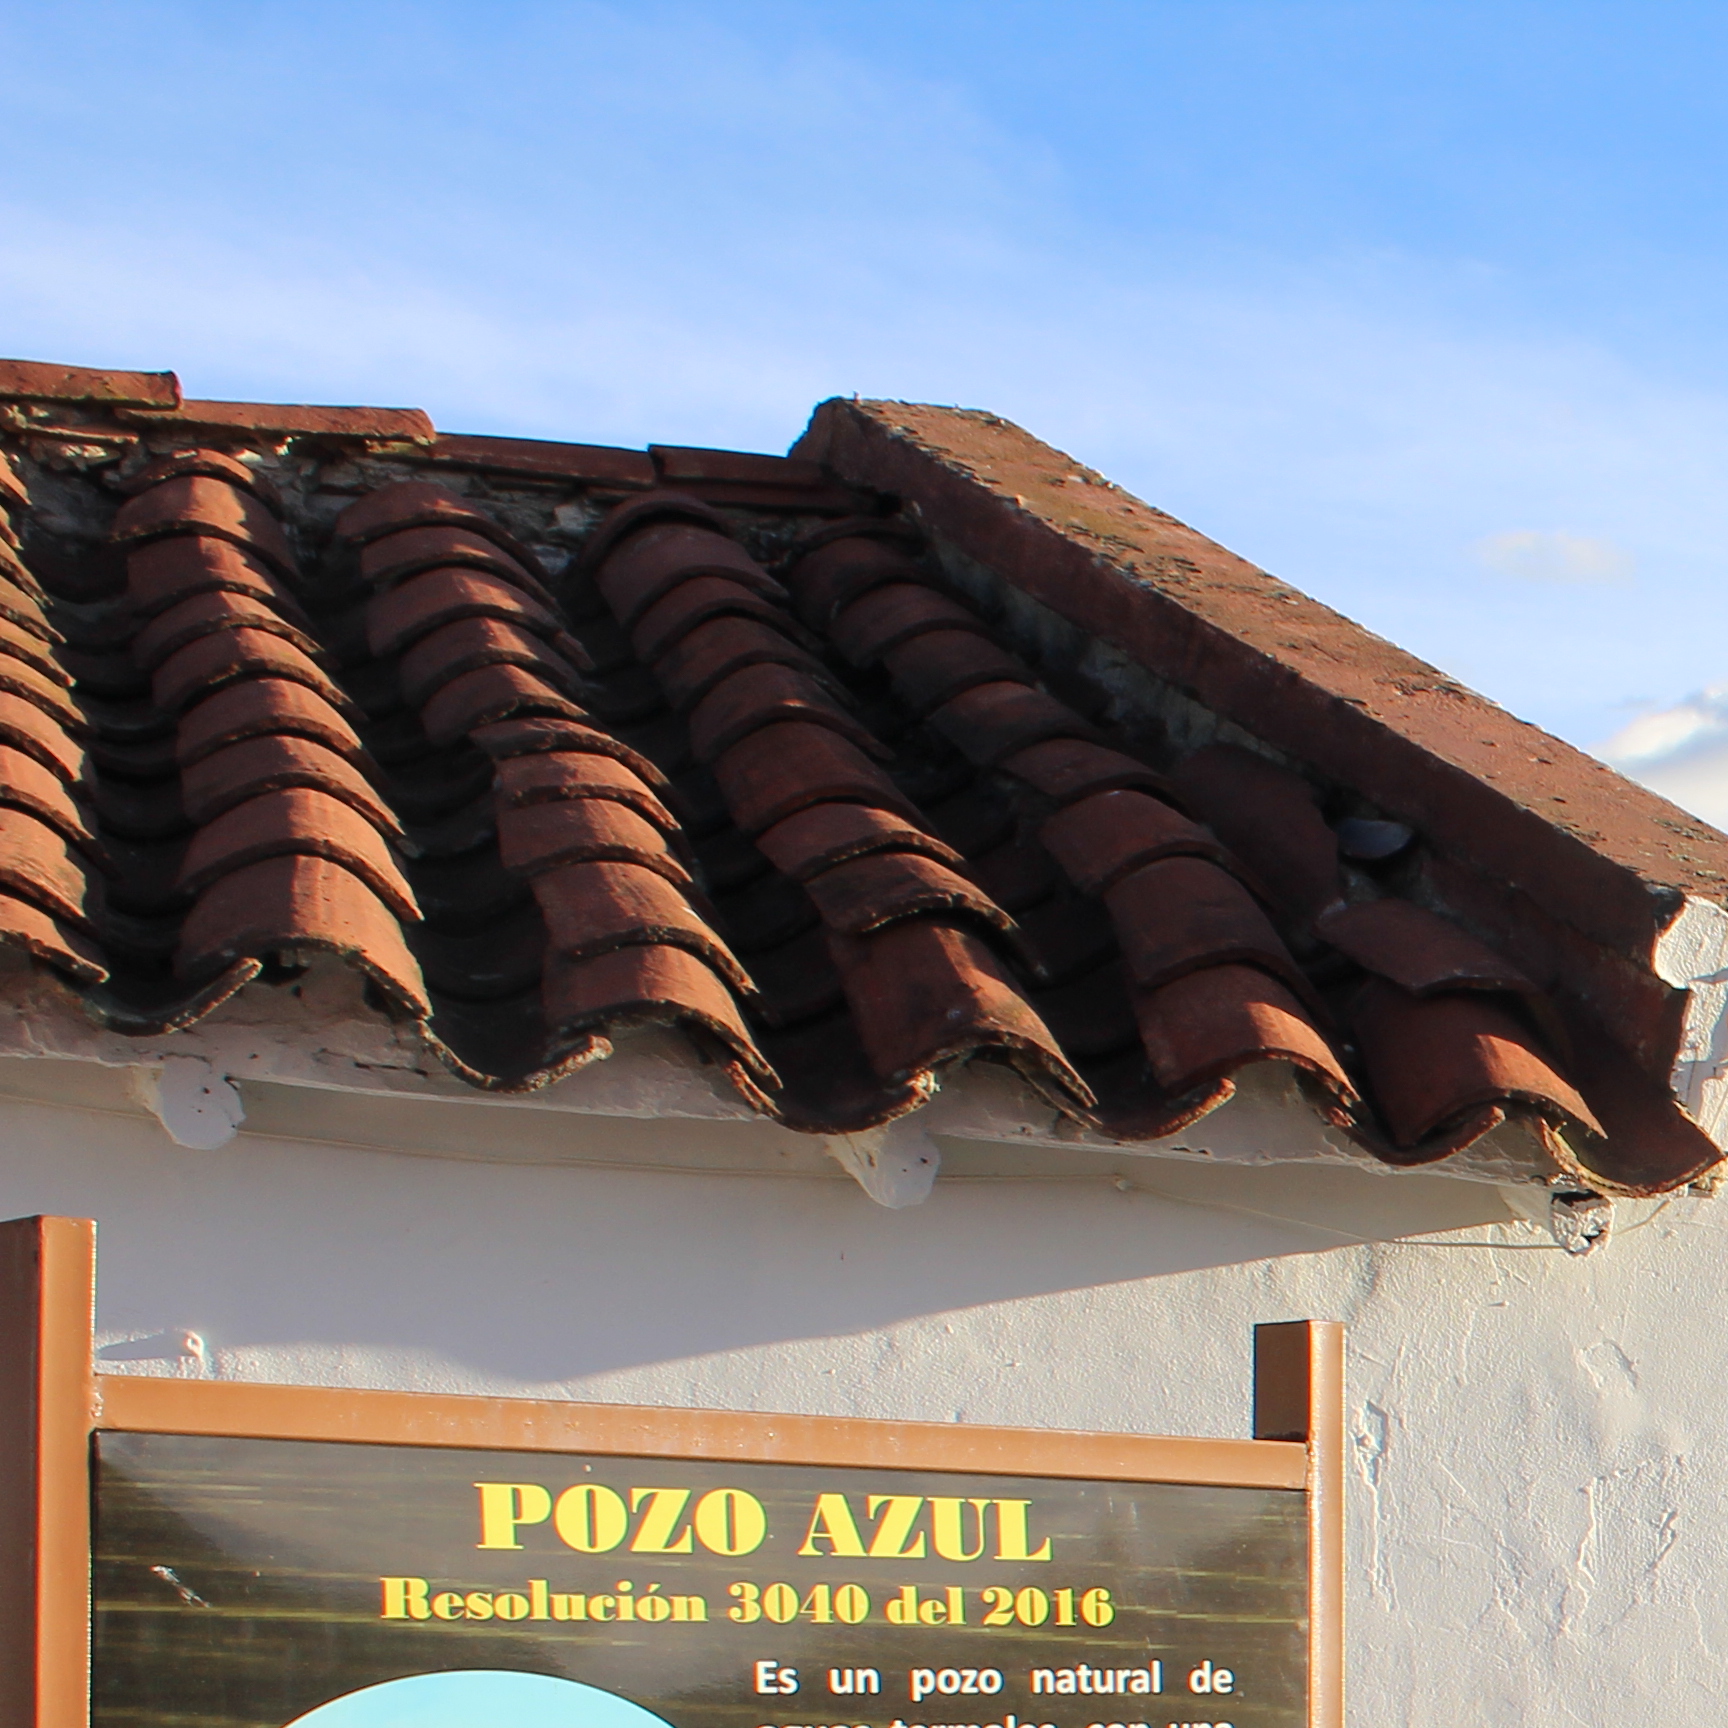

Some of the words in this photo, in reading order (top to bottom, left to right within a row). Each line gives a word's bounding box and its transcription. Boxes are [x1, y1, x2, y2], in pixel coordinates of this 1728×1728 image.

[473, 1483, 765, 1555] POZO
[797, 1494, 1050, 1560] AZUL
[379, 1577, 708, 1626] Resolución
[725, 1582, 868, 1623] 3040
[884, 1586, 966, 1624] del
[981, 1587, 1113, 1626] 2016
[754, 1661, 797, 1693] Es
[828, 1669, 879, 1693] un
[910, 1669, 1002, 1701] pozo
[1030, 1661, 1160, 1693] natural
[1188, 1661, 1232, 1693] de
